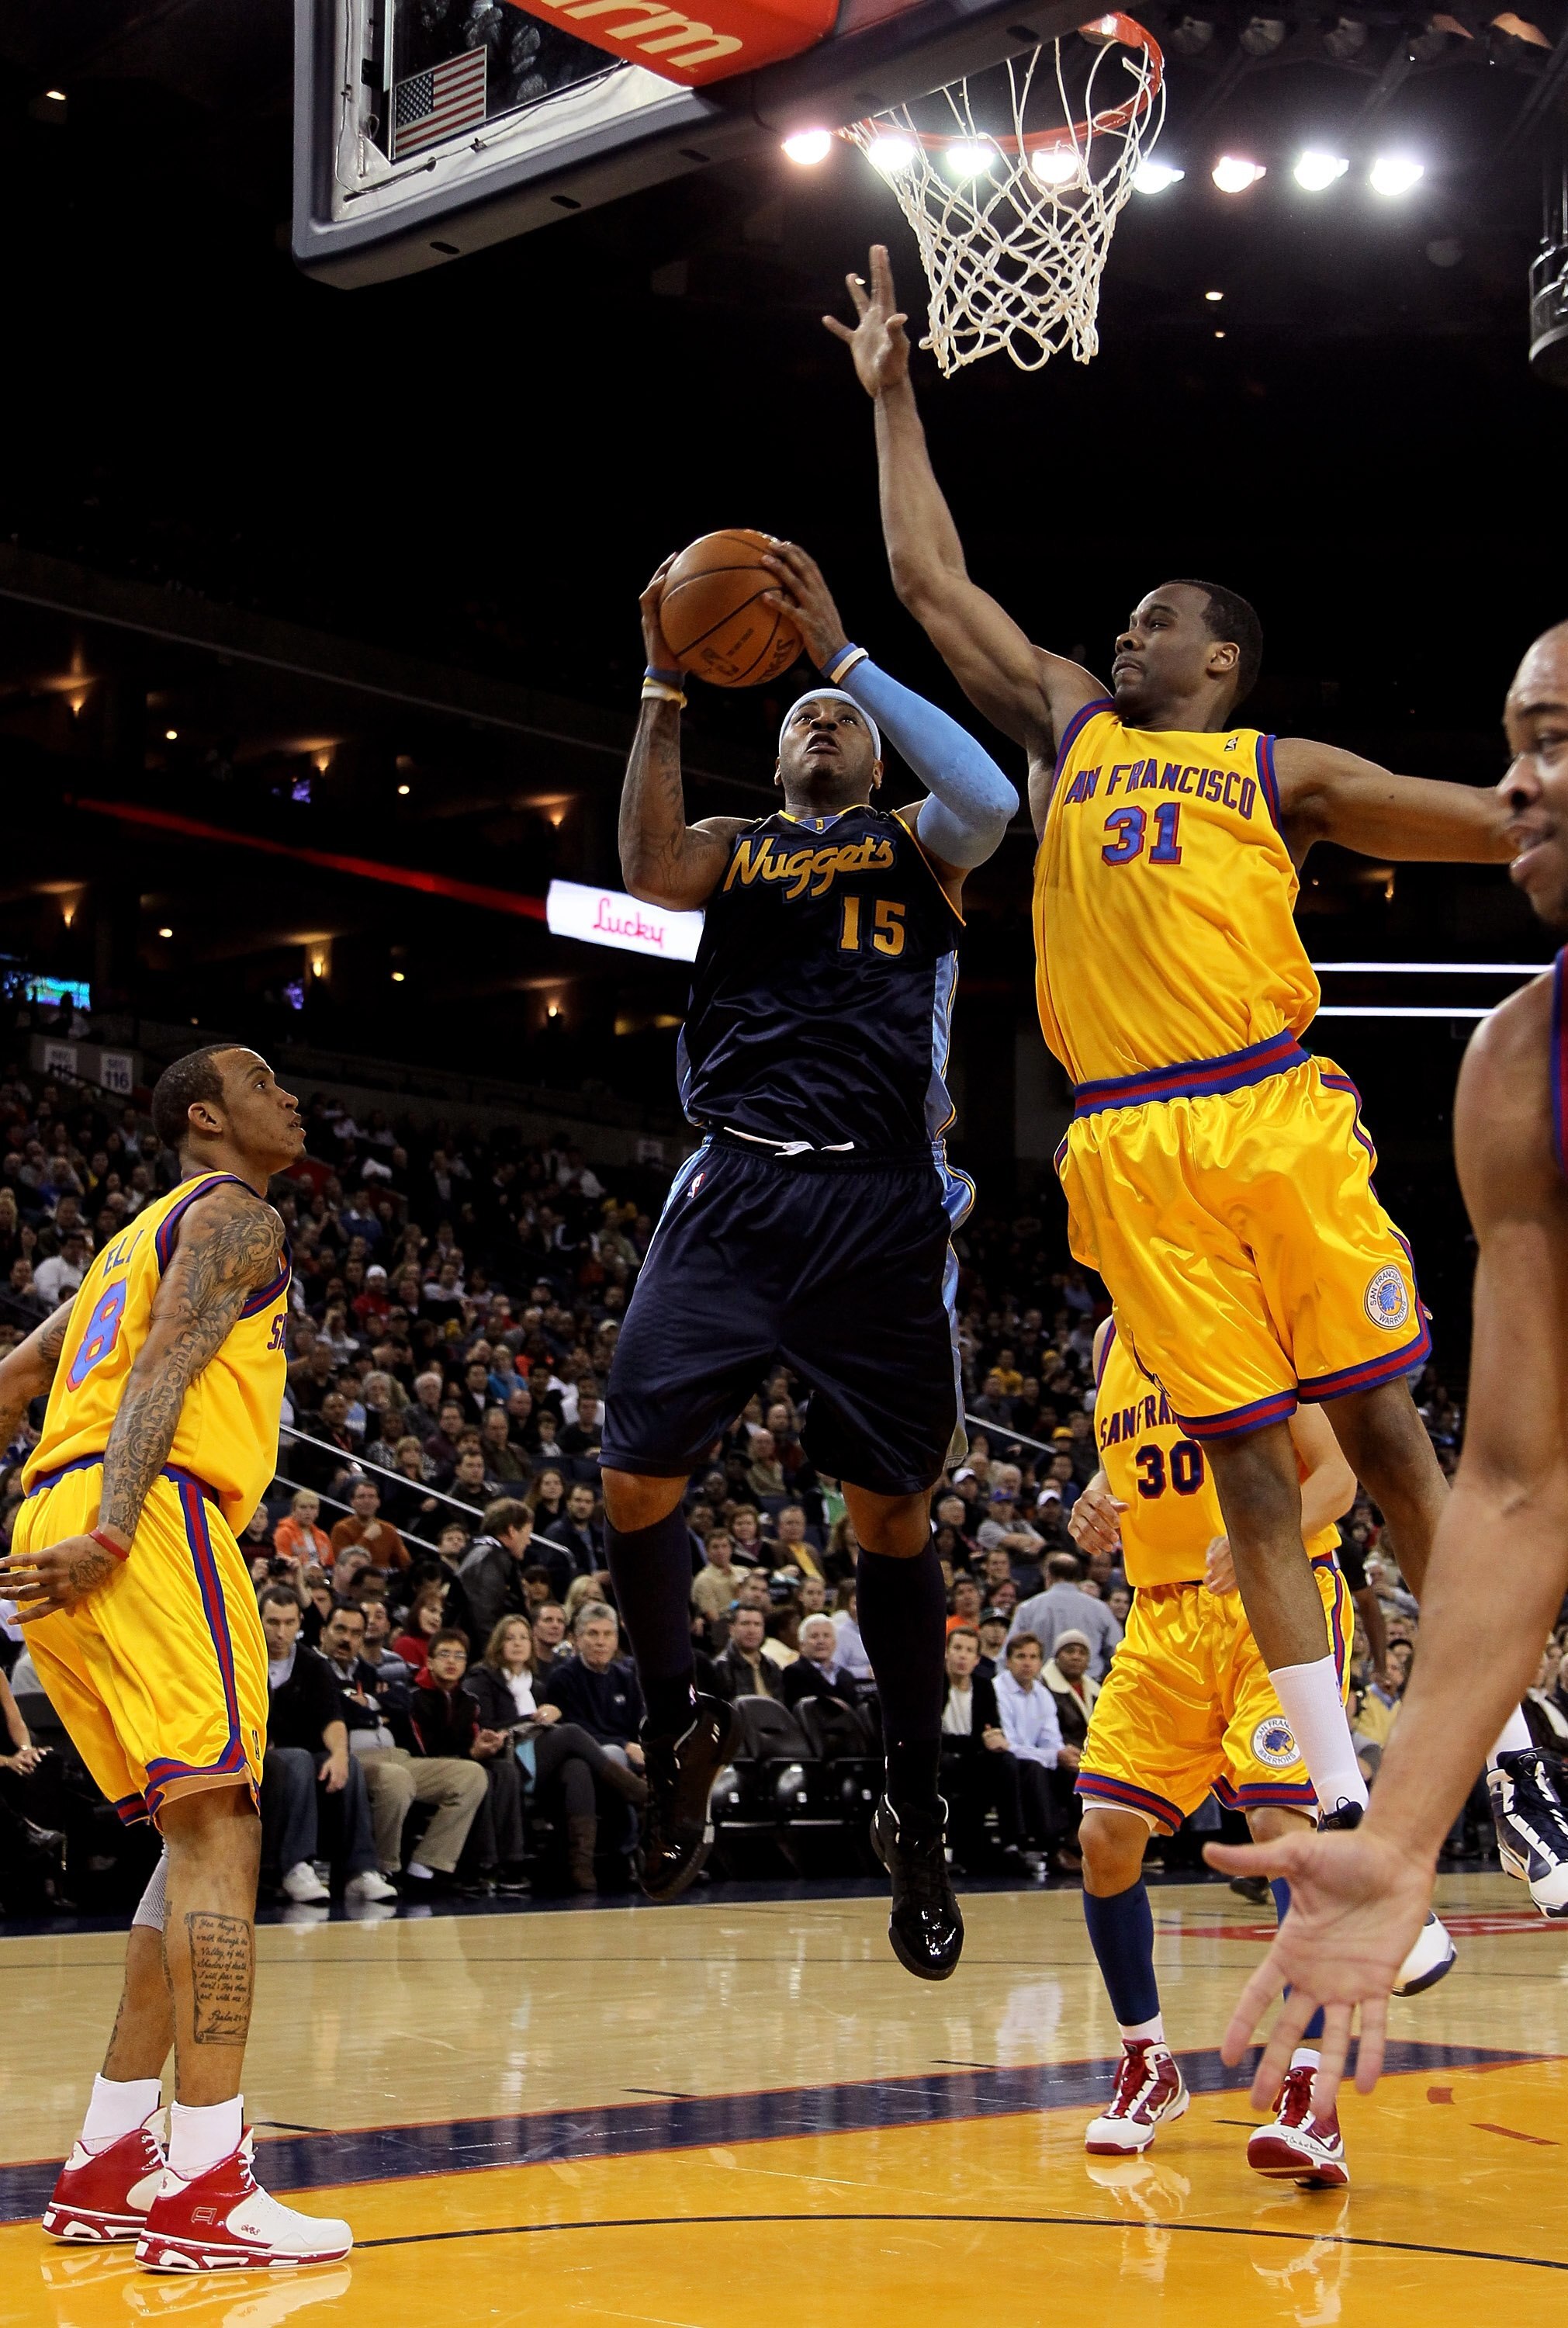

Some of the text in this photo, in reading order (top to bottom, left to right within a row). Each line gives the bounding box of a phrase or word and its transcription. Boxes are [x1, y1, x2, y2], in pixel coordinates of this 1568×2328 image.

[1106, 758, 1257, 820] FRANCISCO
[1102, 802, 1182, 866] 31
[722, 836, 895, 900] Nuggets
[593, 897, 664, 948] Lucky
[840, 896, 906, 956] 15
[66, 1279, 126, 1394] 8
[1379, 1301, 1406, 1325] WARRIORS
[1099, 1406, 1136, 1453] SAN
[1135, 1439, 1204, 1499] 30
[1256, 1725, 1269, 1740] SAN
[1258, 1749, 1296, 1764] WARRIORS
